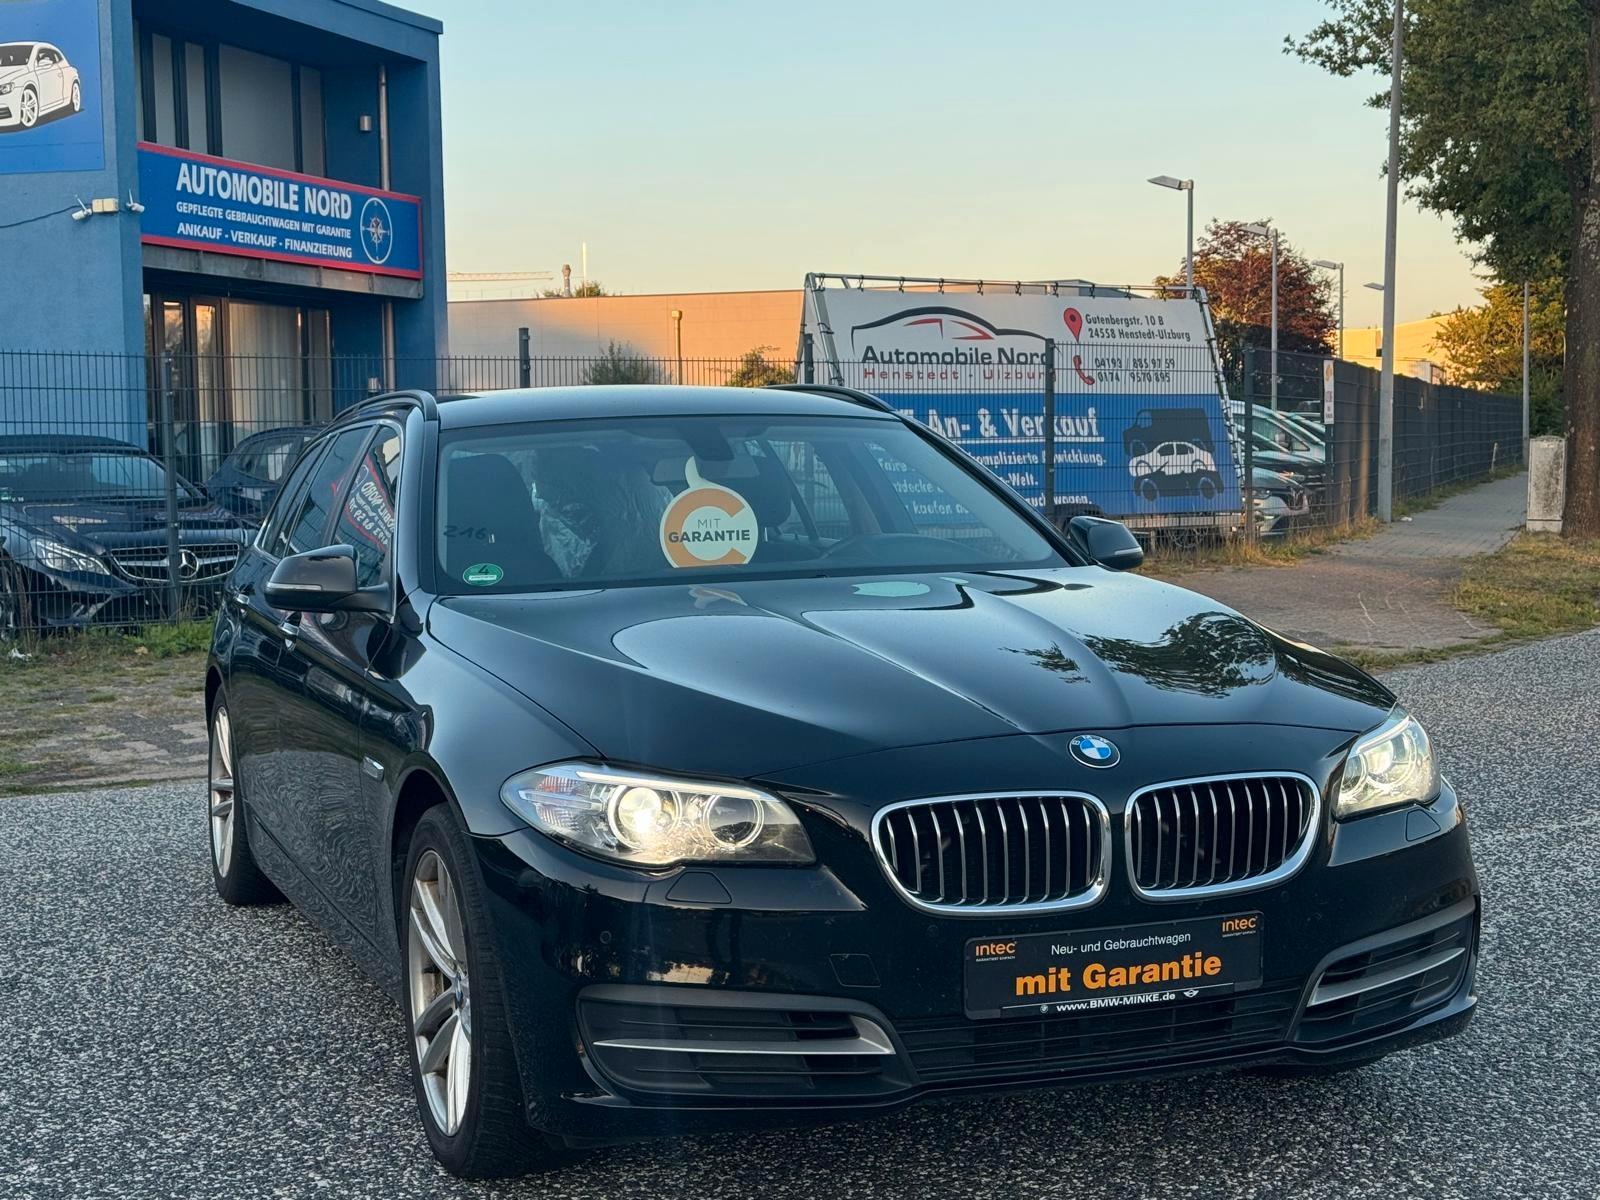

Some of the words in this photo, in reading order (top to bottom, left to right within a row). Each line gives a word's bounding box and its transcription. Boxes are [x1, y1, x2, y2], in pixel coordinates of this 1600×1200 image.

[176, 162, 299, 212] AUTOMOBILE
[304, 187, 352, 220] NORD
[176, 201, 224, 219] GEPFLEGTE
[225, 210, 300, 231] GEBRAUCHTWAGEN
[301, 222, 315, 233] MIT
[316, 224, 351, 239] GARANTIE
[177, 222, 223, 240] ANKAUF
[230, 229, 277, 247] VERKAUF
[284, 239, 352, 258] FINANZIERUNG
[1085, 313, 1143, 327] Gutenbergstr.
[1145, 315, 1156, 326] 10
[1158, 315, 1164, 326] B
[1088, 327, 1116, 339] 24558
[1118, 329, 1191, 341] Henstedt-Ulzburg
[861, 345, 992, 366] Automobile
[863, 367, 960, 380] Henstedt
[928, 408, 970, 438] An-
[977, 407, 998, 438] &
[697, 518, 721, 529] MIT
[668, 529, 751, 543] GARANTIE
[478, 564, 490, 576] 4
[1222, 917, 1257, 933] intec
[975, 941, 1016, 957] intec
[1051, 943, 1078, 956] Neu-
[1081, 940, 1101, 953] und
[1104, 932, 1191, 951] Gebrauchtwagen
[1015, 967, 1071, 996] mit
[1083, 951, 1222, 990] Garantie
[1056, 992, 1176, 1012] www.BMW-MINKE.de
